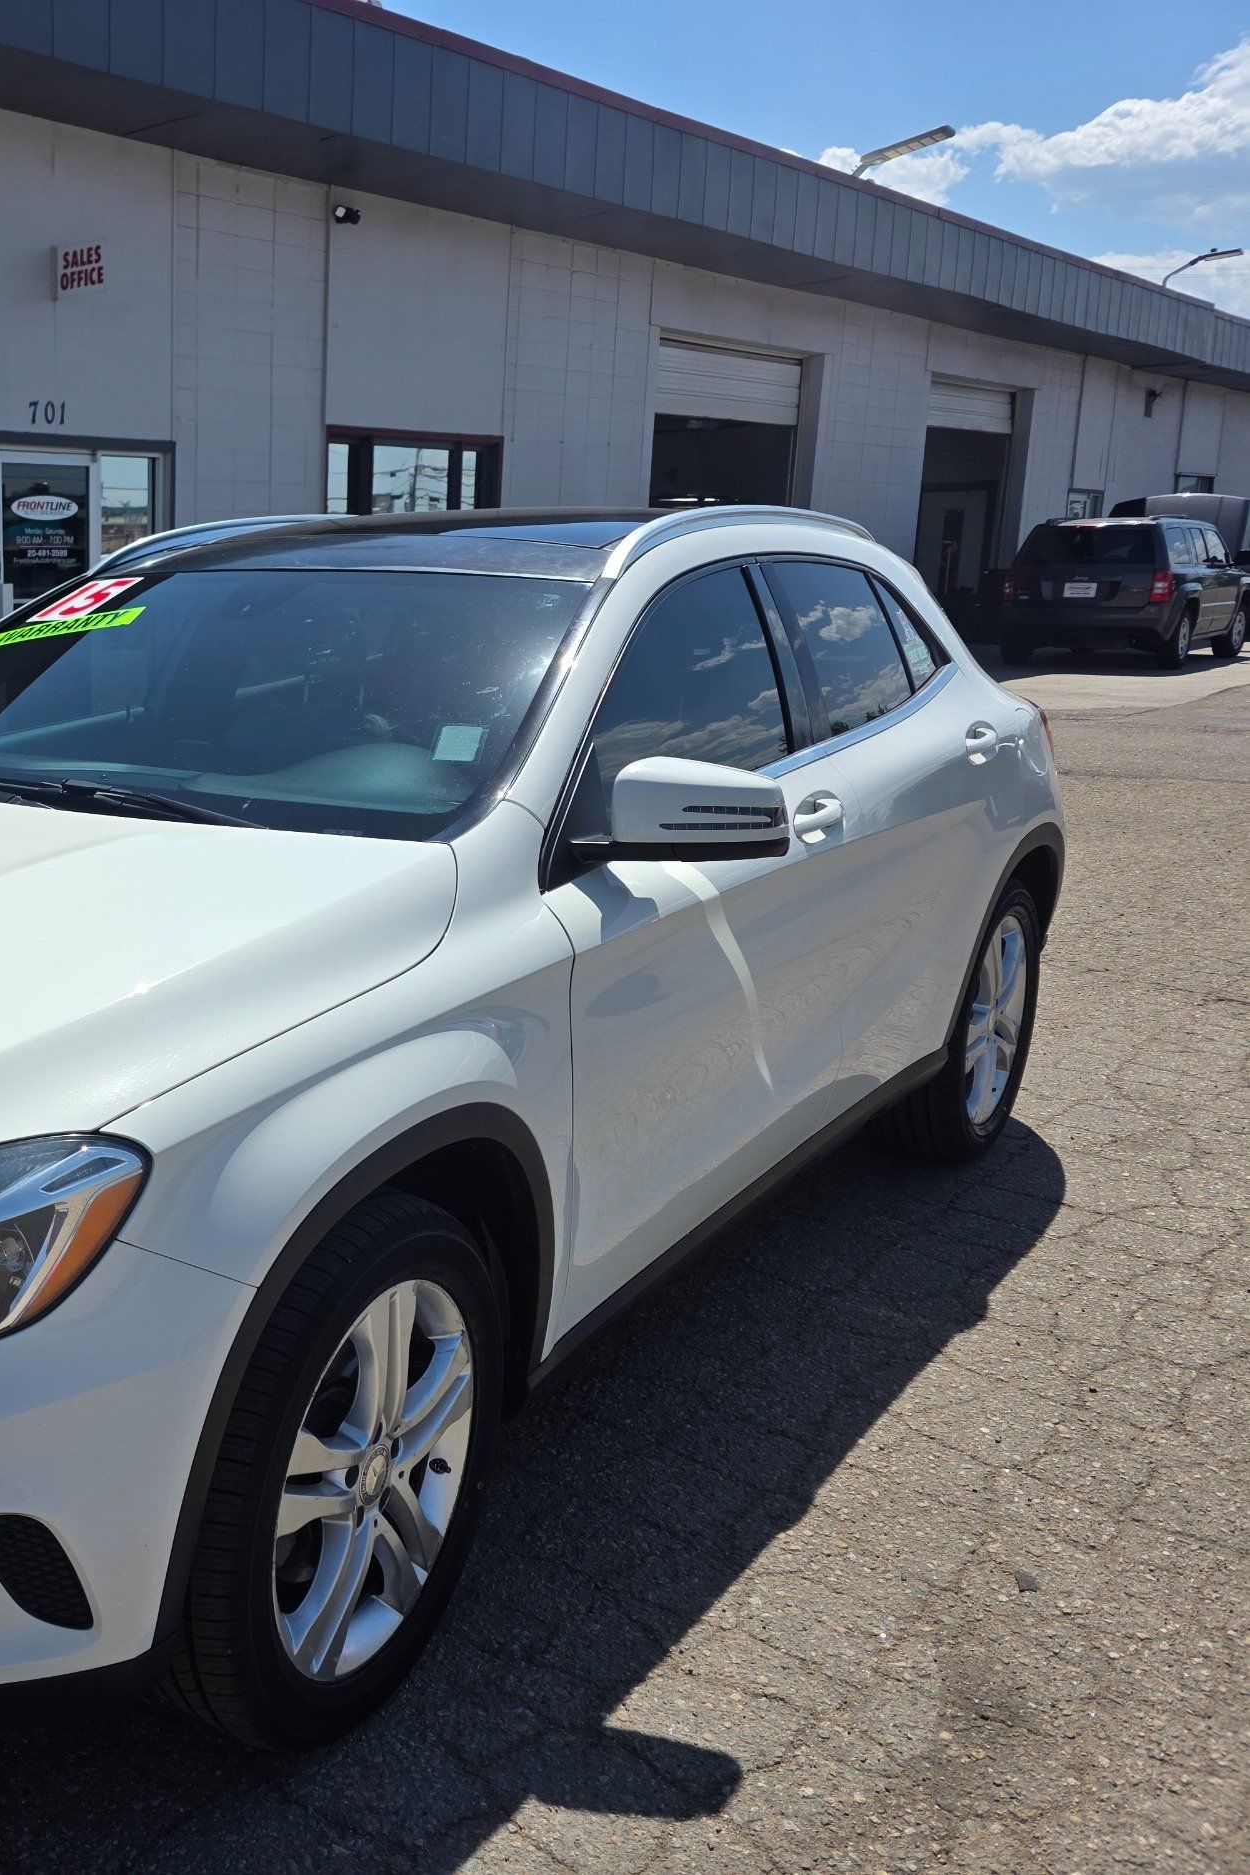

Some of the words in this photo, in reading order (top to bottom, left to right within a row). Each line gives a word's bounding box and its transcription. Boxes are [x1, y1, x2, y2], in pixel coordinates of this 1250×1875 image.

[63, 245, 102, 270] SALES
[60, 266, 104, 291] OFFICE
[29, 400, 66, 425] 701
[17, 501, 73, 511] FRONTLINE
[36, 579, 137, 618] 15
